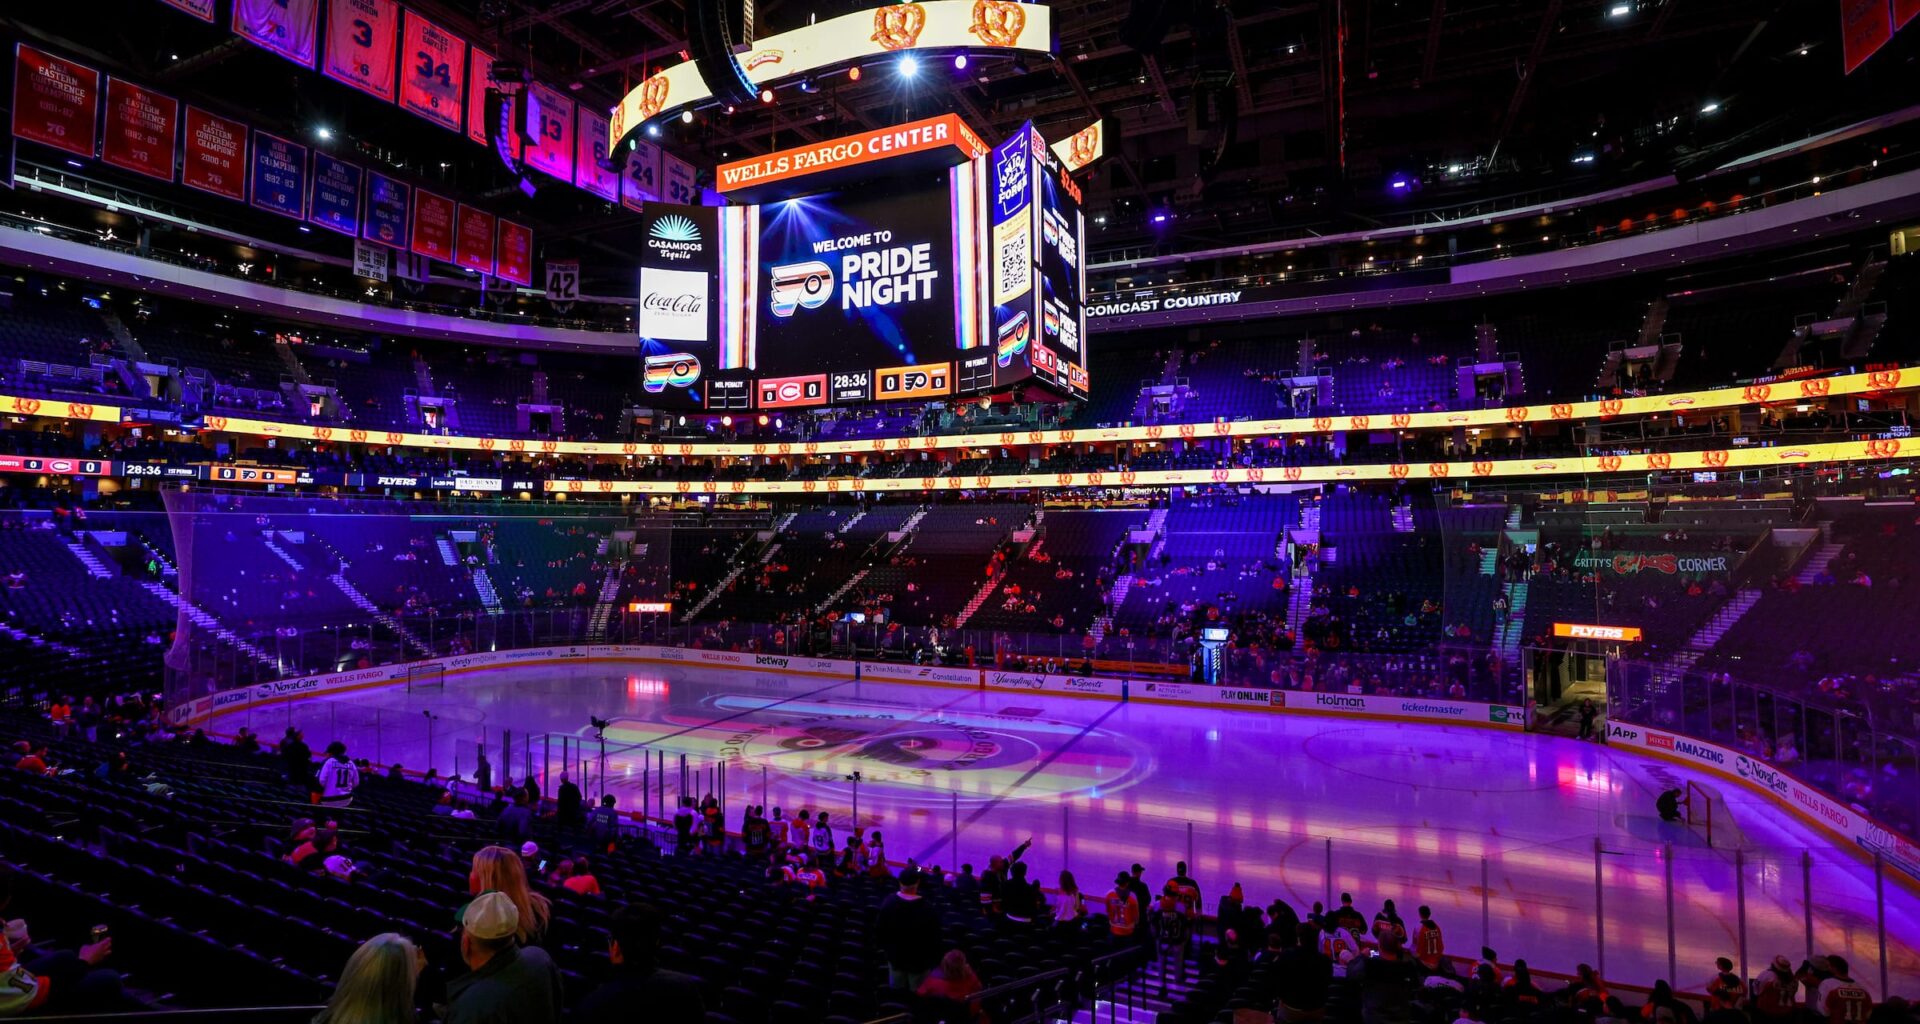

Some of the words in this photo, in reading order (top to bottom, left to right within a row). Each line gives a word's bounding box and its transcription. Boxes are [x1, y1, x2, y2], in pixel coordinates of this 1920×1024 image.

[352, 19, 373, 48] 3
[38, 66, 78, 86] EASTERN
[416, 51, 451, 88] 34
[30, 72, 86, 97] CONFERENCE
[32, 81, 83, 106] CHAMPIONS
[125, 98, 160, 115] EASTERN
[118, 104, 167, 126] CONFERENCE
[120, 112, 165, 134] CHAMPIONS
[46, 122, 66, 136] 76
[202, 124, 233, 140] EASTERN
[540, 114, 562, 141] 13
[196, 130, 237, 150] CONFERENCE
[958, 122, 982, 152] WELLS
[131, 148, 148, 162] 76
[198, 138, 235, 157] CHAMPIONS
[723, 156, 789, 185] WELLS
[793, 141, 863, 171] FARGO
[868, 123, 948, 154] CENTER
[269, 149, 292, 163] WORLD
[208, 173, 222, 185] 76
[632, 160, 653, 186] 24
[318, 174, 355, 194] CHAMPIONS
[670, 180, 689, 203] 32
[648, 239, 703, 251] CASAMIGOS
[813, 233, 871, 254] WELCOME
[873, 230, 892, 243] TO
[660, 249, 691, 261] Tequila
[842, 242, 931, 283] PRIDE
[549, 272, 575, 298] 42
[842, 270, 938, 310] NIGHT
[1086, 300, 1160, 317] COMCAST
[1164, 291, 1242, 309] COUNTRY
[834, 373, 867, 388] 28:36
[886, 376, 895, 390] 0
[935, 377, 942, 387] 0
[766, 392, 773, 400] 0
[808, 383, 816, 396] 0
[29, 461, 37, 469] 0
[85, 462, 95, 473] 0
[126, 464, 162, 476] 28:36
[223, 469, 231, 478] 0
[377, 476, 417, 486] FLYERS
[513, 481, 528, 489] APRIL
[1575, 558, 1612, 568] GRITTY'S
[1612, 553, 1678, 574] CHAOS
[1678, 556, 1727, 572] CORNER
[1571, 626, 1624, 638] FLYERS
[451, 658, 472, 668] xfinity
[472, 655, 497, 663] mobile
[506, 651, 546, 659] Independence
[702, 653, 721, 661] WELLS
[756, 655, 789, 668] betway
[817, 661, 832, 669] peco
[273, 678, 319, 694] NovaCare
[326, 675, 355, 685] WELLS
[357, 671, 384, 681] FARGO
[932, 673, 972, 683] Constellation
[992, 672, 1035, 687] Yuengling
[1077, 678, 1104, 688] Sports
[1221, 690, 1236, 699] PLAY
[1237, 691, 1269, 702] ONLINE
[1317, 693, 1365, 707] Holman
[1402, 702, 1464, 715] ticketmaster
[1648, 735, 1672, 748] MIKE'S
[1675, 740, 1724, 764] AMAZING
[1750, 761, 1788, 793] NovaCare
[1793, 787, 1819, 811] WELLS
[1820, 802, 1848, 828] FARGO
[1844, 1001, 1863, 1021] 11
